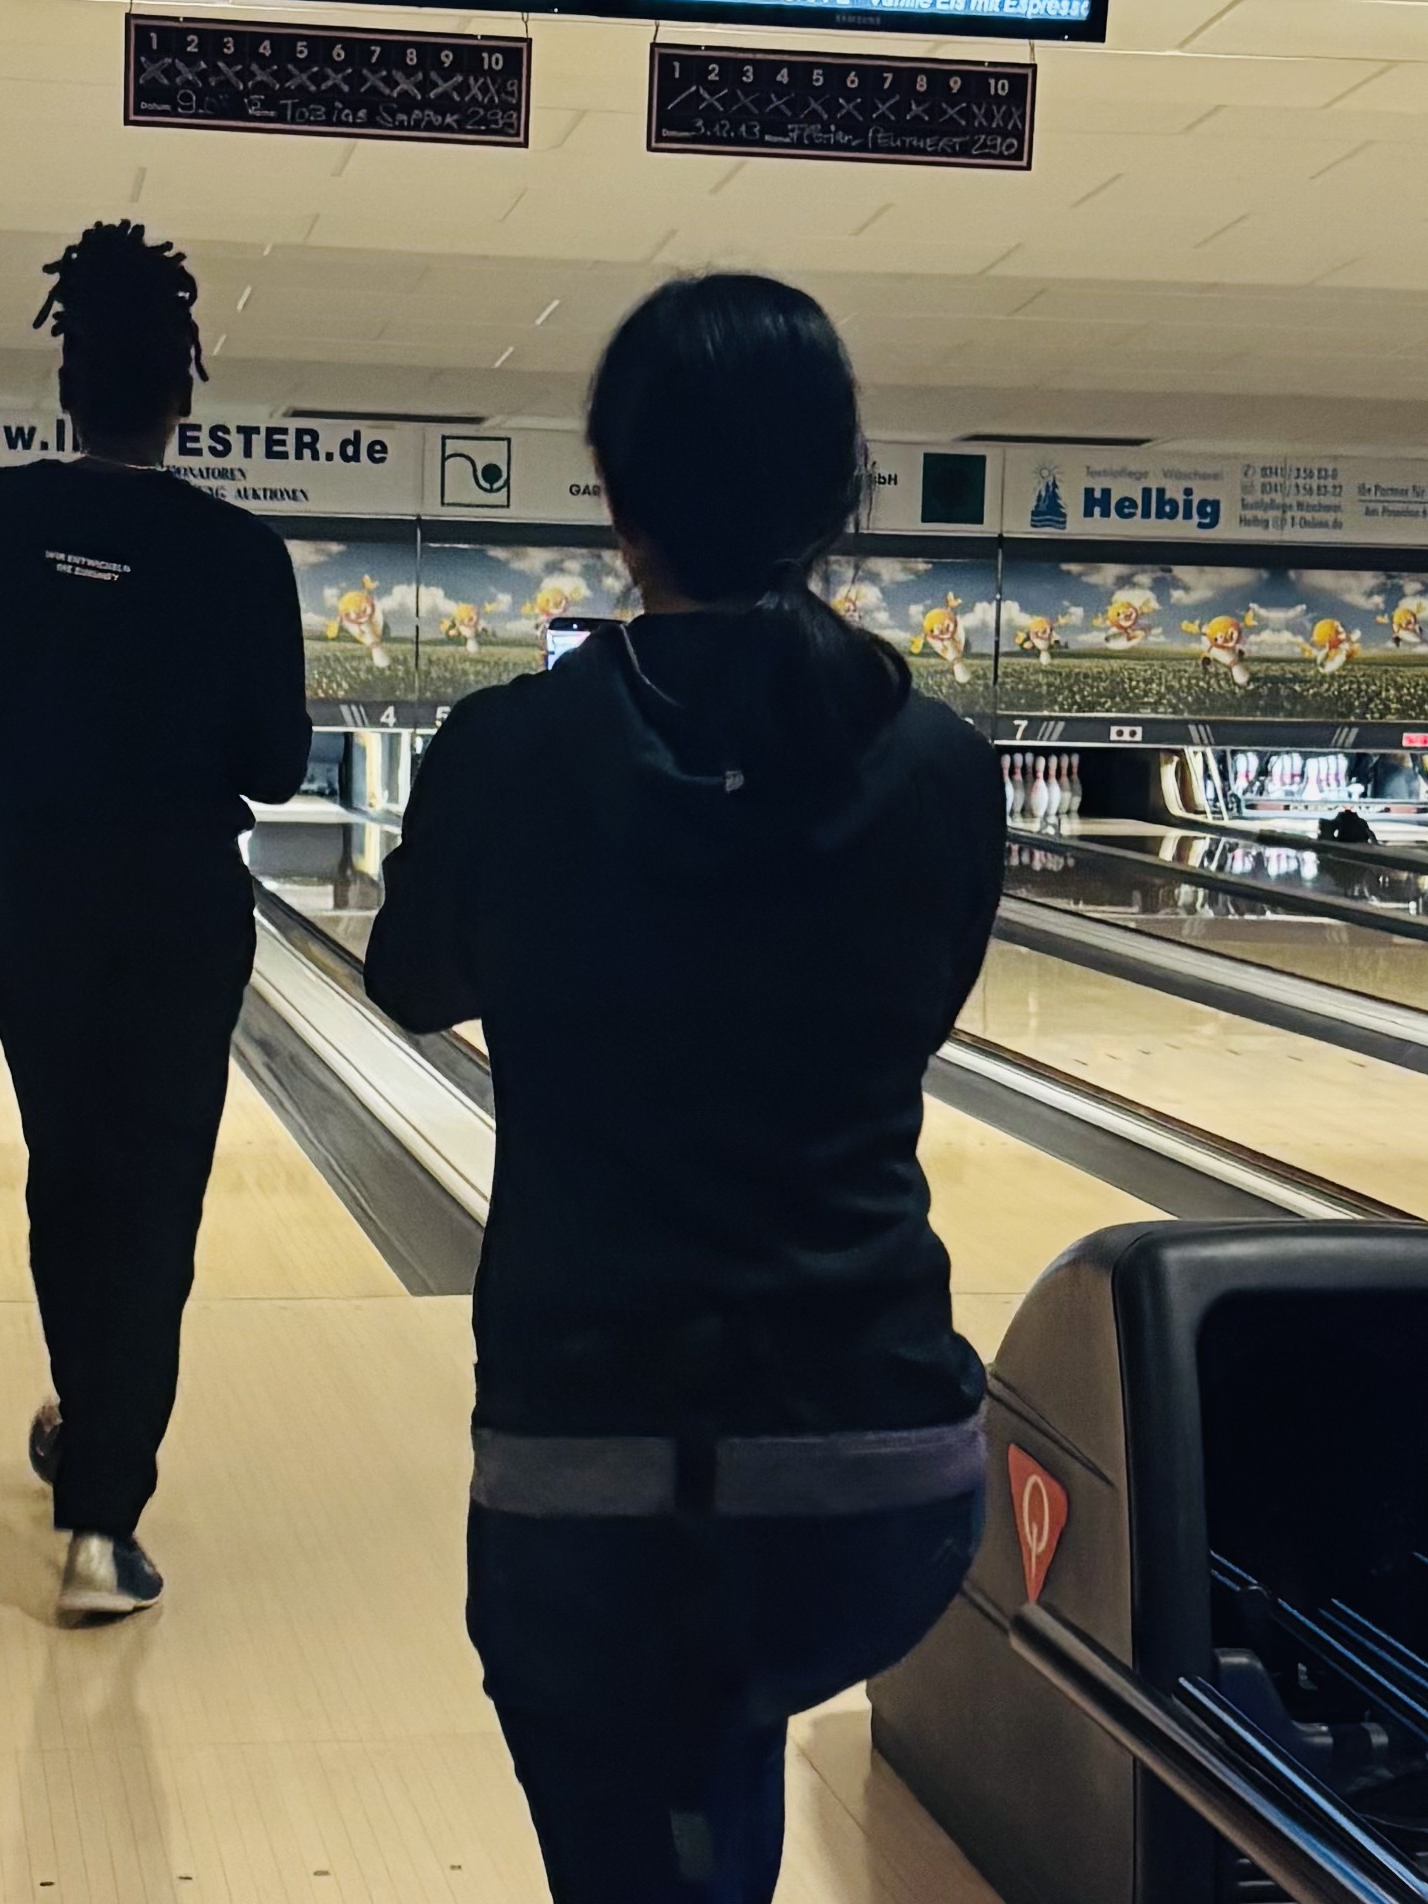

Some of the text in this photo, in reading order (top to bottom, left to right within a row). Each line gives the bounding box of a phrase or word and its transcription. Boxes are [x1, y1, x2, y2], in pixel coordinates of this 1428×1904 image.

[150, 33, 503, 70] 1 2 3 4 5 6 7 8 9 10
[1083, 486, 1221, 530] Helbig
[380, 705, 397, 727] 4
[435, 706, 451, 727] 5
[1012, 720, 1028, 740] 7
